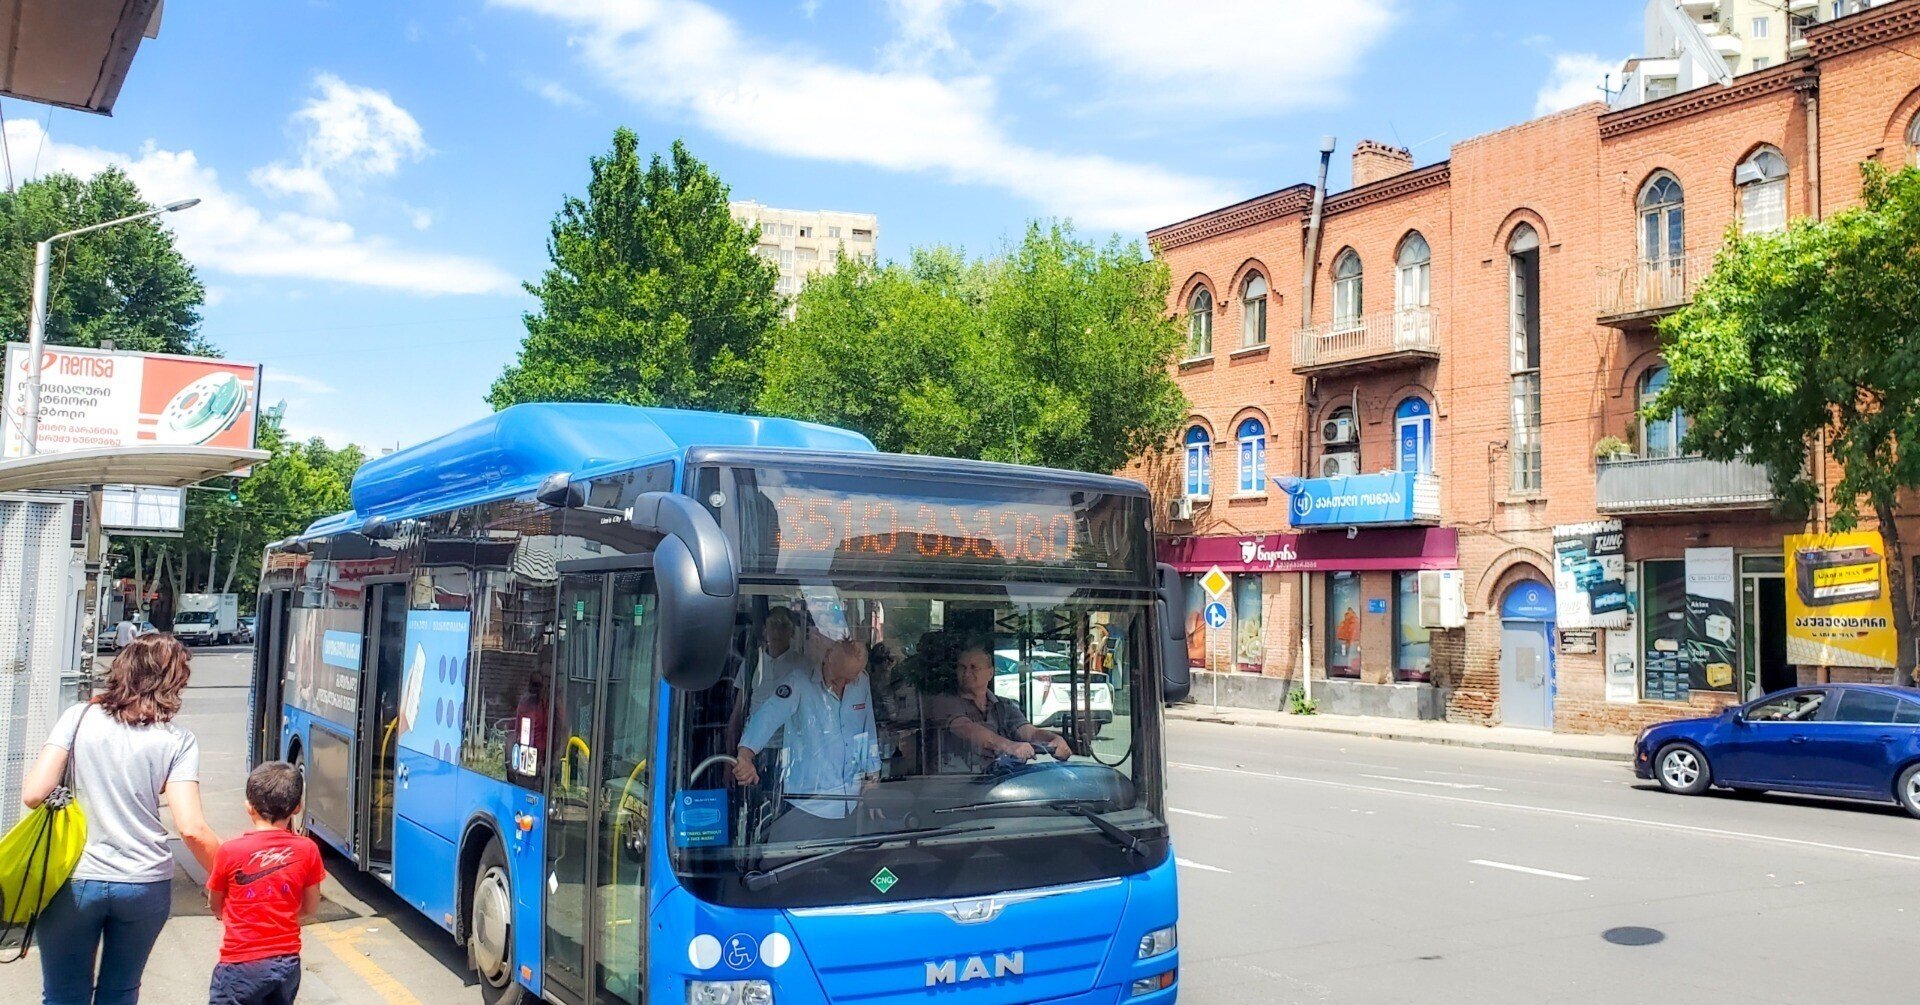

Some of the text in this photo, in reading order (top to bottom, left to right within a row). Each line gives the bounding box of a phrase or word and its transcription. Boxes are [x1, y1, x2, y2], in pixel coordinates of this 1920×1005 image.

[1315, 494, 1358, 509] ქართული
[1360, 492, 1401, 507] ოცნება
[776, 496, 851, 551] 351
[1795, 617, 1887, 628] აკუმულატორი
[247, 847, 294, 868] Flight
[875, 876, 893, 884] CNG
[924, 950, 1024, 987] MAN
